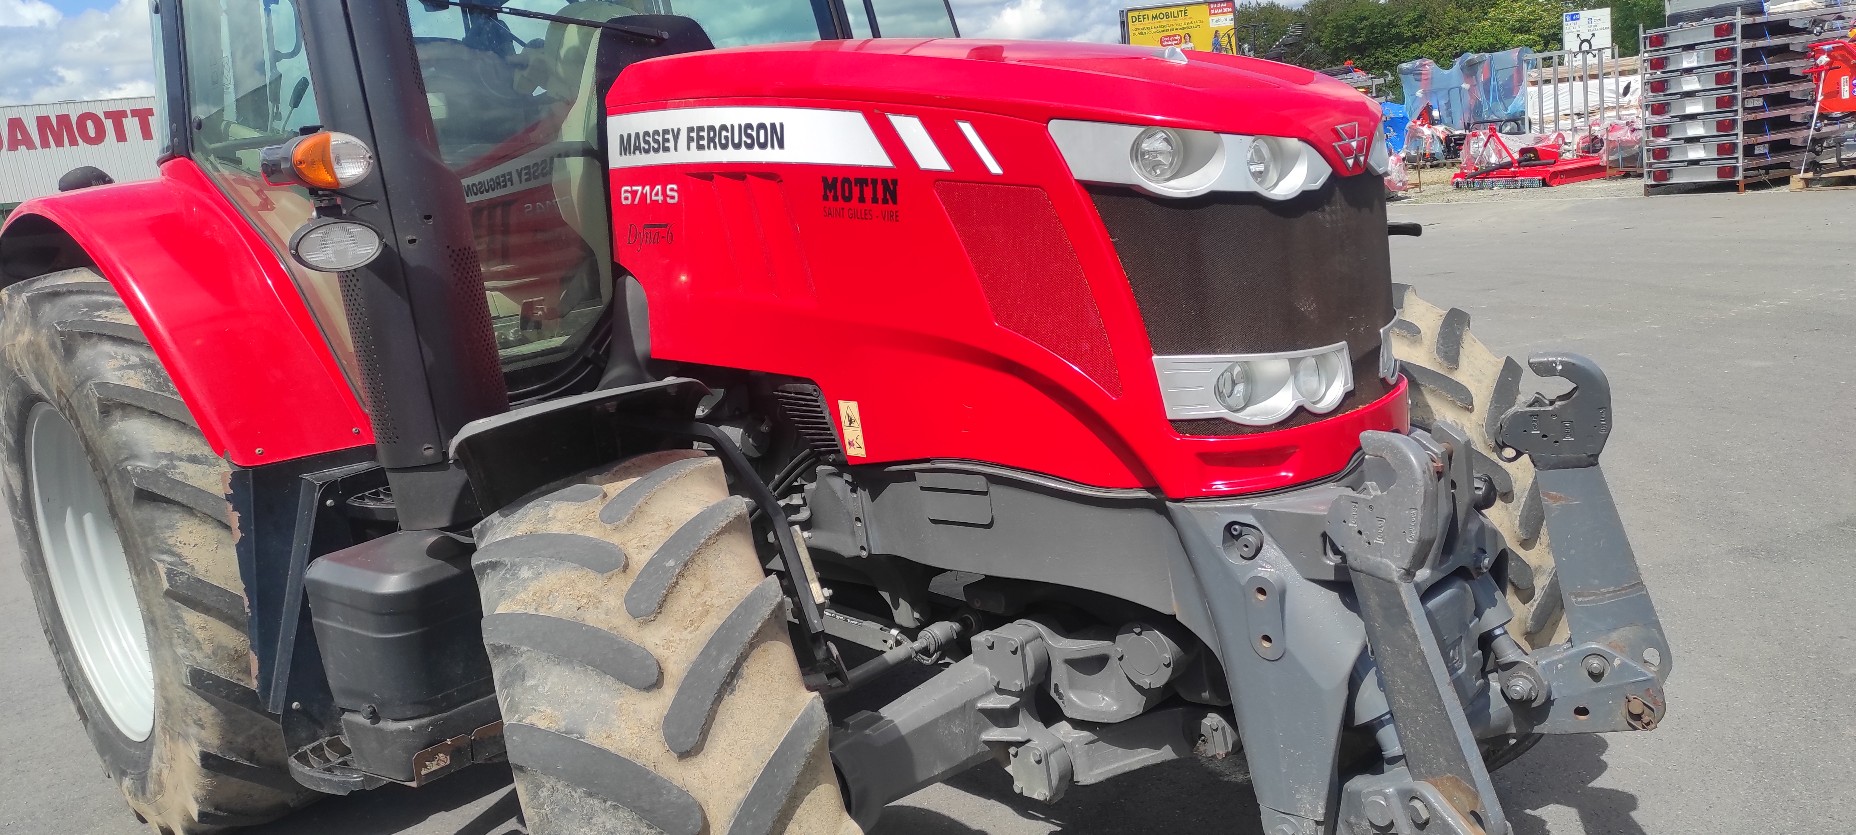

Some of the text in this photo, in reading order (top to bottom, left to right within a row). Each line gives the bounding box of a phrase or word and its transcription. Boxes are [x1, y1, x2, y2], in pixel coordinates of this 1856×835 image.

[1131, 12, 1150, 23] DÉFI
[1151, 8, 1188, 21] MOBILITÉ
[0, 107, 155, 152] AMOTT
[619, 122, 785, 157] MASSEY FERGUSON
[822, 176, 898, 205] MOTIN
[823, 206, 845, 218] SAINT
[847, 207, 873, 220] GILLES
[881, 210, 899, 222] VIRE
[627, 223, 674, 252] Dyna-6
